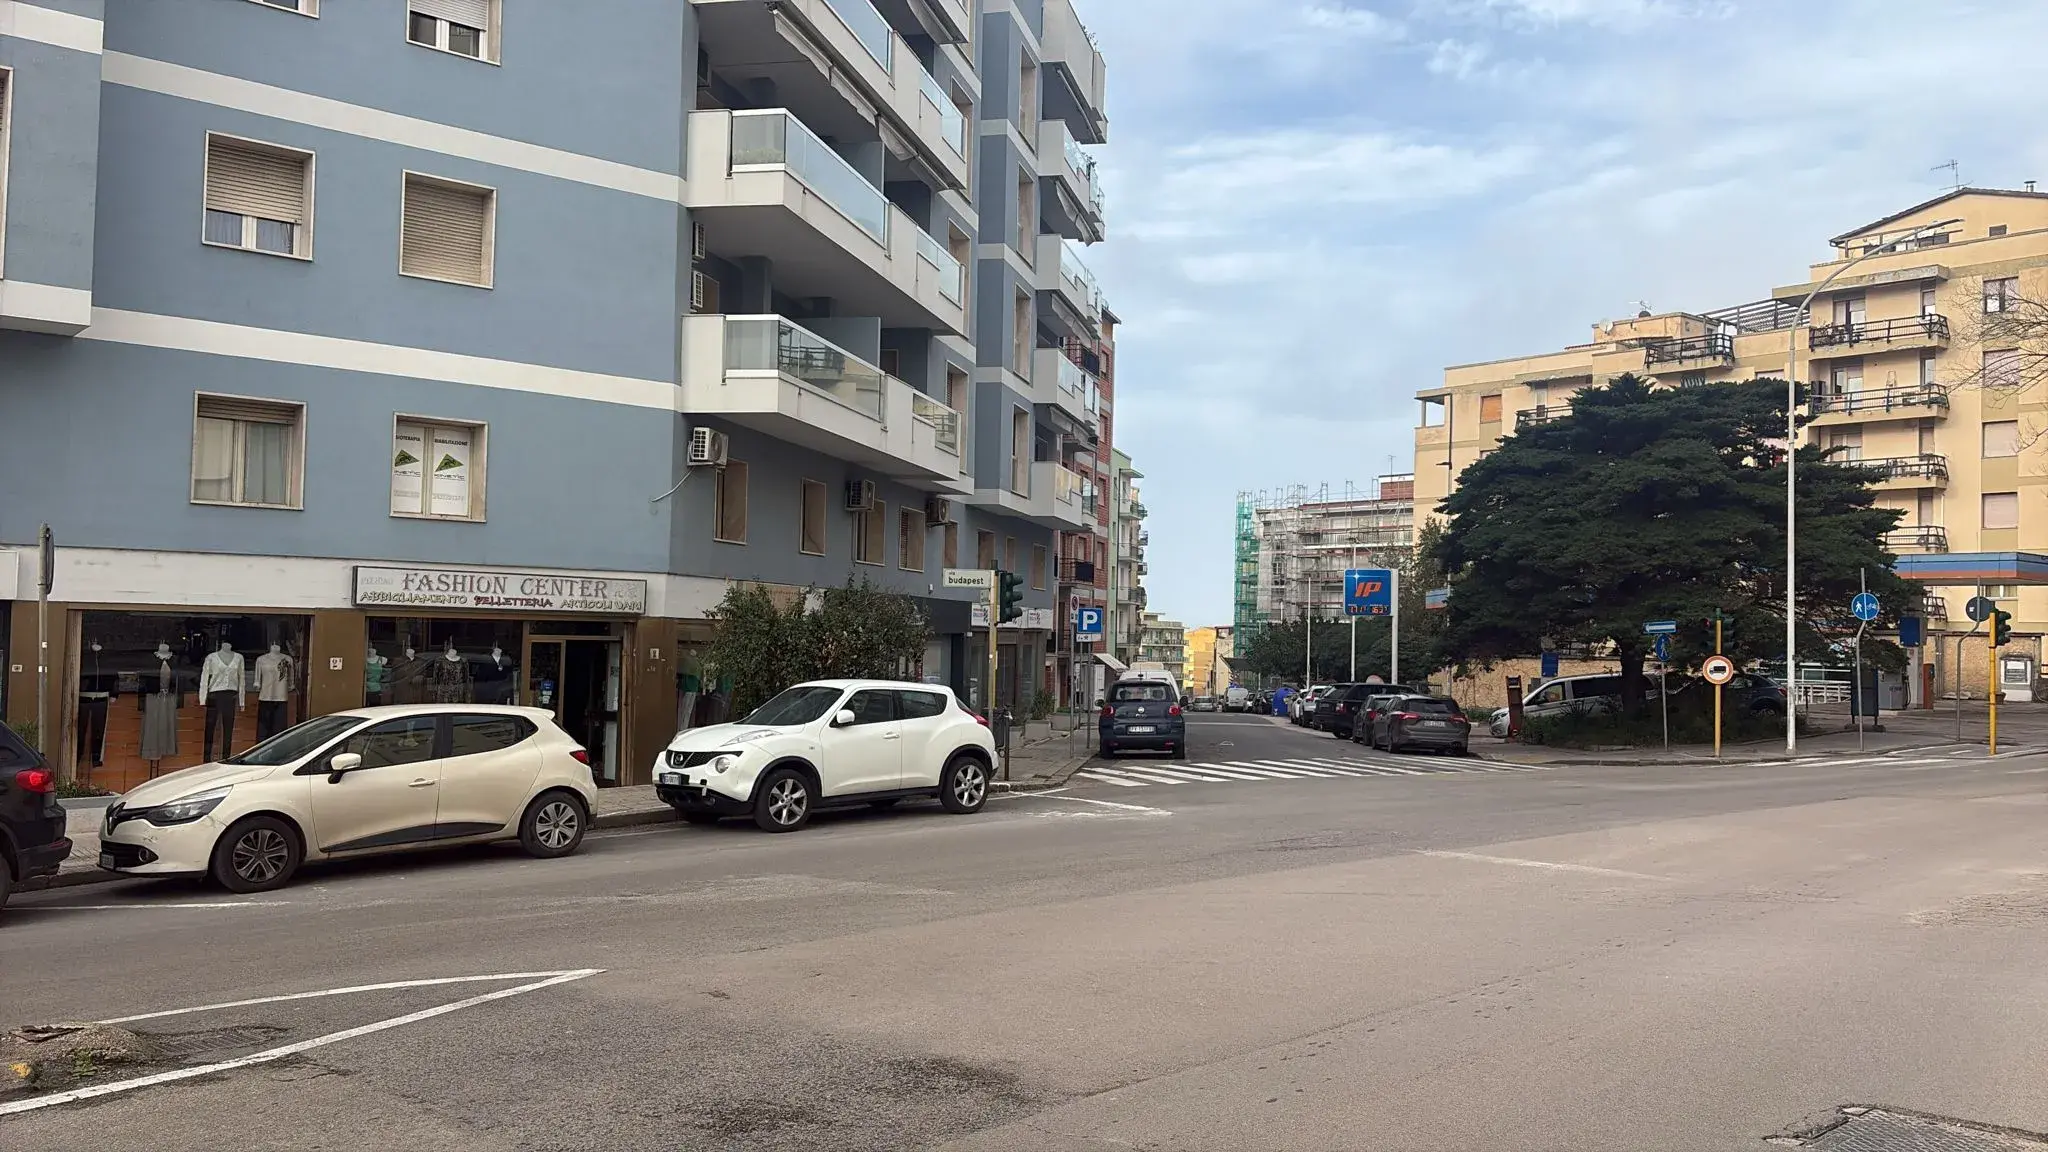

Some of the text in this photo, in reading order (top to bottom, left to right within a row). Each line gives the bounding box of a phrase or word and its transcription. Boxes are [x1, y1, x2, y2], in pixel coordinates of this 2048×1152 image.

[402, 573, 508, 594] FASHION
[520, 577, 608, 599] CENTER
[948, 576, 984, 585] budapest
[1355, 582, 1382, 597] IP
[360, 591, 468, 605] ABBIGLIAMENTO
[473, 595, 553, 608] PELLETTERIA
[560, 599, 613, 610] ARTICOLI
[1082, 610, 1098, 631] P
